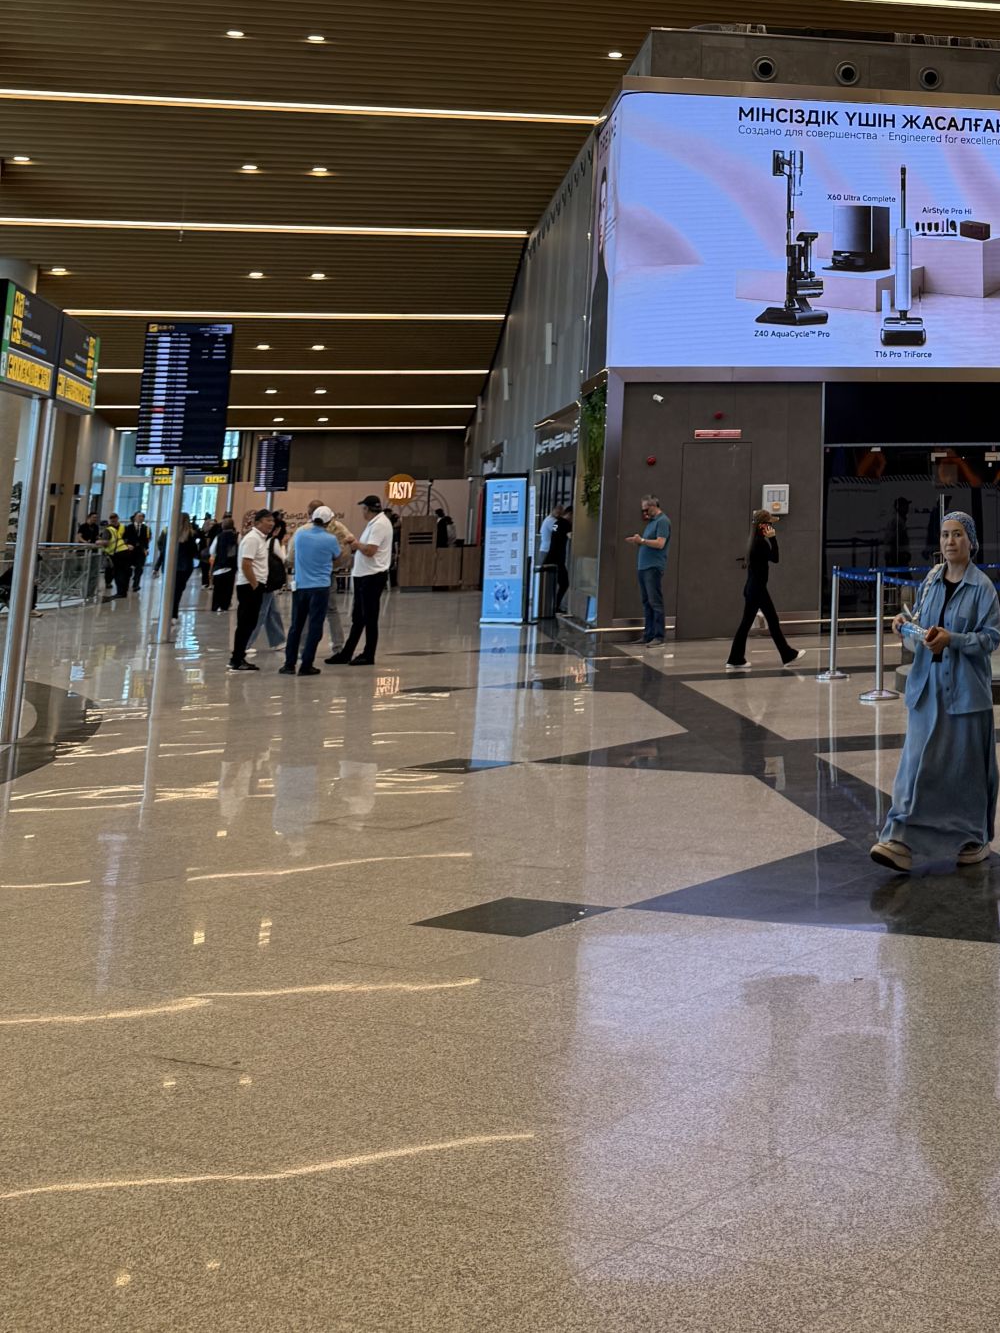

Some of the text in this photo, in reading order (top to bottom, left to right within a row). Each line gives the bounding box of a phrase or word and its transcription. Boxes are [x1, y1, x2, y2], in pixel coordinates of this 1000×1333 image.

[738, 106, 839, 127] МІНСІЗДІК
[738, 125, 782, 136] Создано
[785, 128, 803, 137] для
[806, 129, 878, 140] совершенства
[889, 132, 942, 143] Engineered
[945, 134, 958, 144] for
[827, 193, 896, 203] X60 Ultra Complete
[922, 207, 949, 215] AirStyle
[388, 481, 414, 500] TASTY
